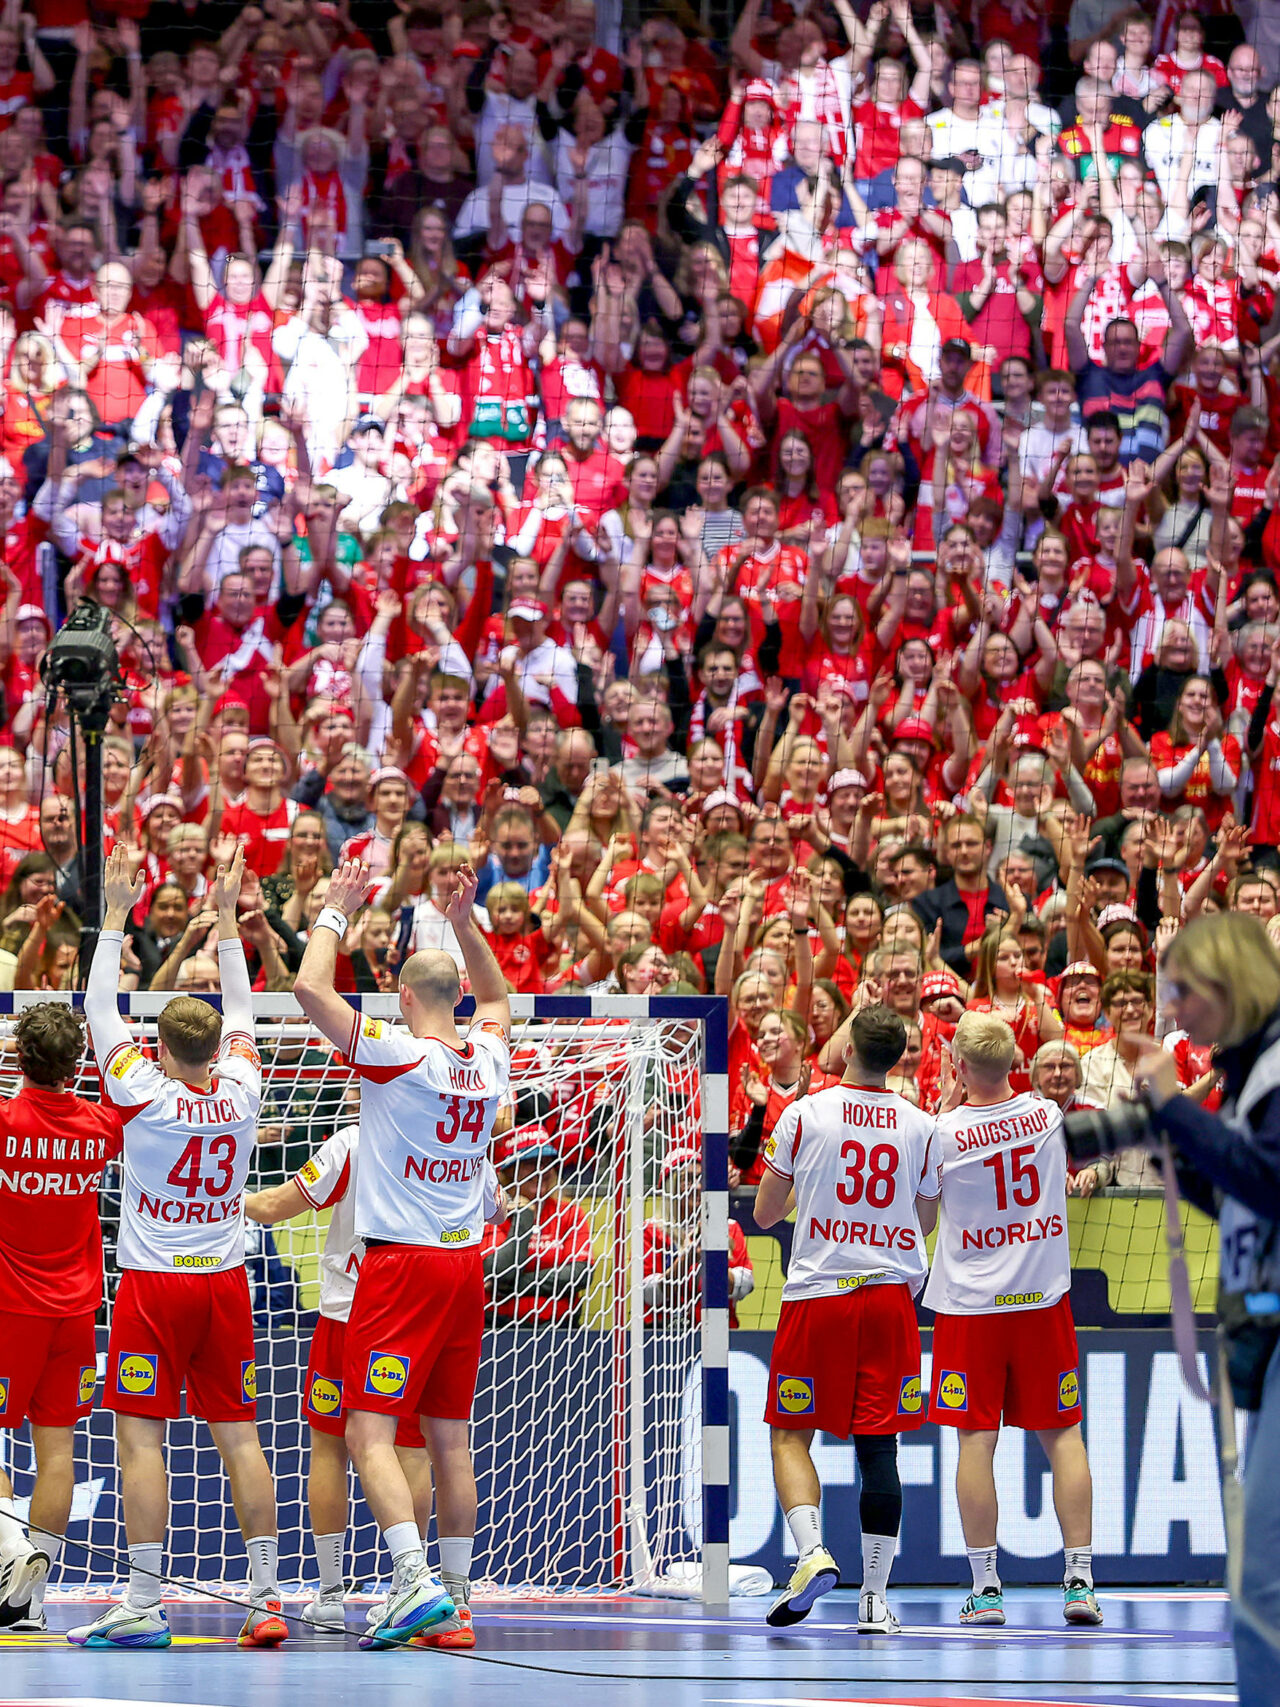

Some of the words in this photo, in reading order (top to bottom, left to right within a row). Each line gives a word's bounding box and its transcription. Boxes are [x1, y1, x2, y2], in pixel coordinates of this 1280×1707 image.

[435, 1092, 490, 1144] 34
[842, 1102, 898, 1129] HOXER
[955, 1107, 1049, 1153] SAUGSTRUP
[166, 1134, 237, 1198] 43
[836, 1139, 900, 1209] 38
[982, 1144, 1041, 1211] 15
[137, 1192, 241, 1224] NORLYS
[440, 1228, 470, 1242] BRUP
[809, 1217, 916, 1251] NORLYS
[962, 1214, 1064, 1250] NORLYS
[173, 1255, 222, 1267] BORUP
[994, 1292, 1044, 1306] BORUP
[681, 1350, 1248, 1558] OFICIA
